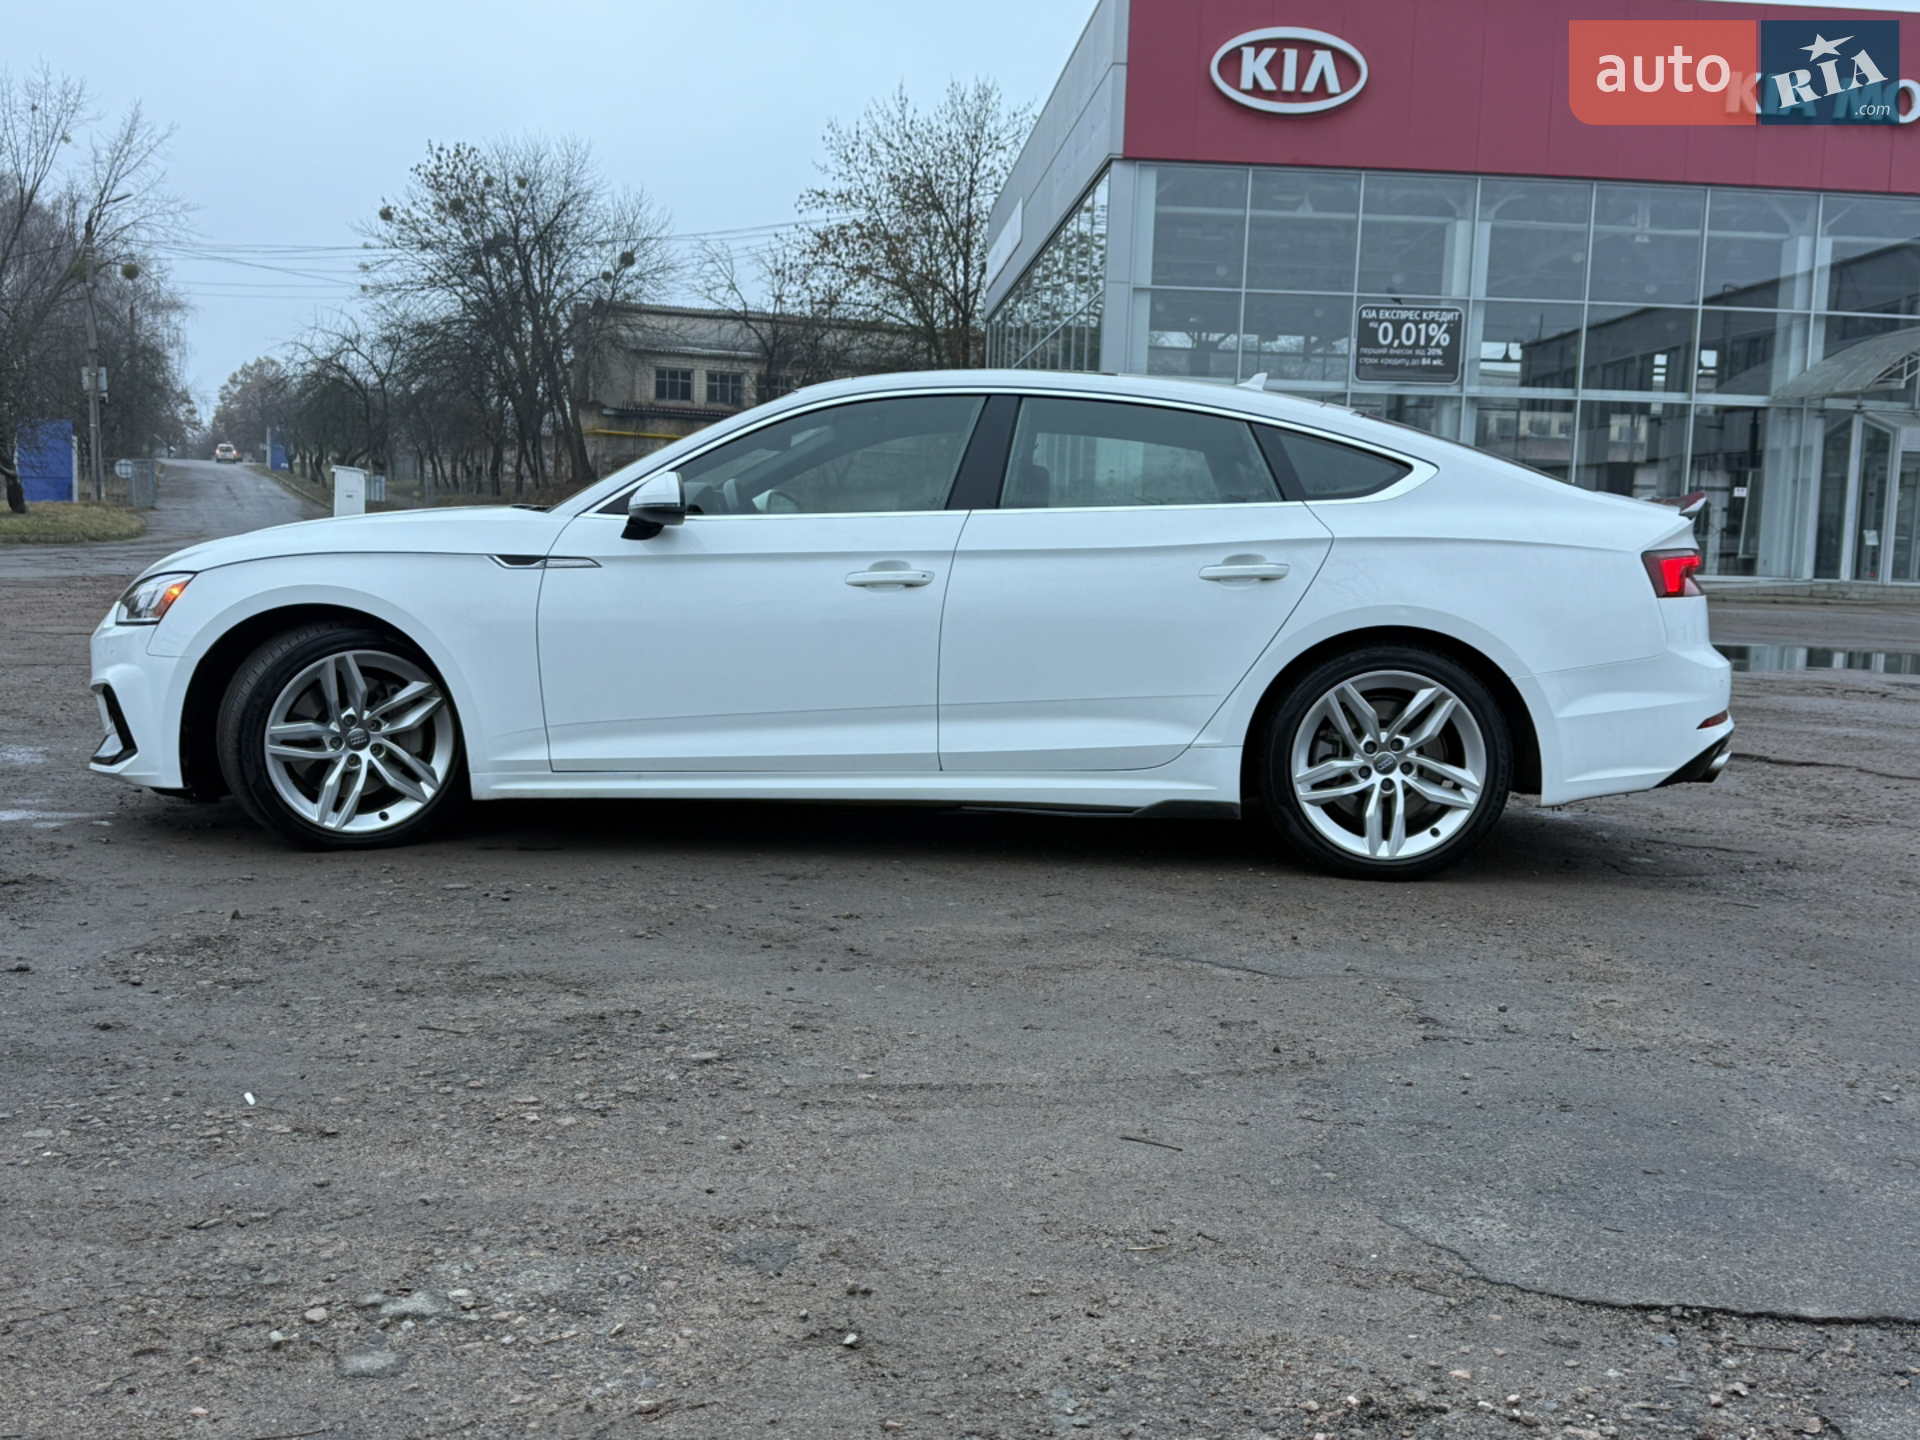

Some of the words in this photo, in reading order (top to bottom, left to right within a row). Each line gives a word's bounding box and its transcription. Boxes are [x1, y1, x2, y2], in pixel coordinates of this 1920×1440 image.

[1240, 47, 1341, 94] KIA
[1379, 310, 1420, 320] ЕКСПРЕС
[1422, 311, 1460, 323] КРЕДИТ
